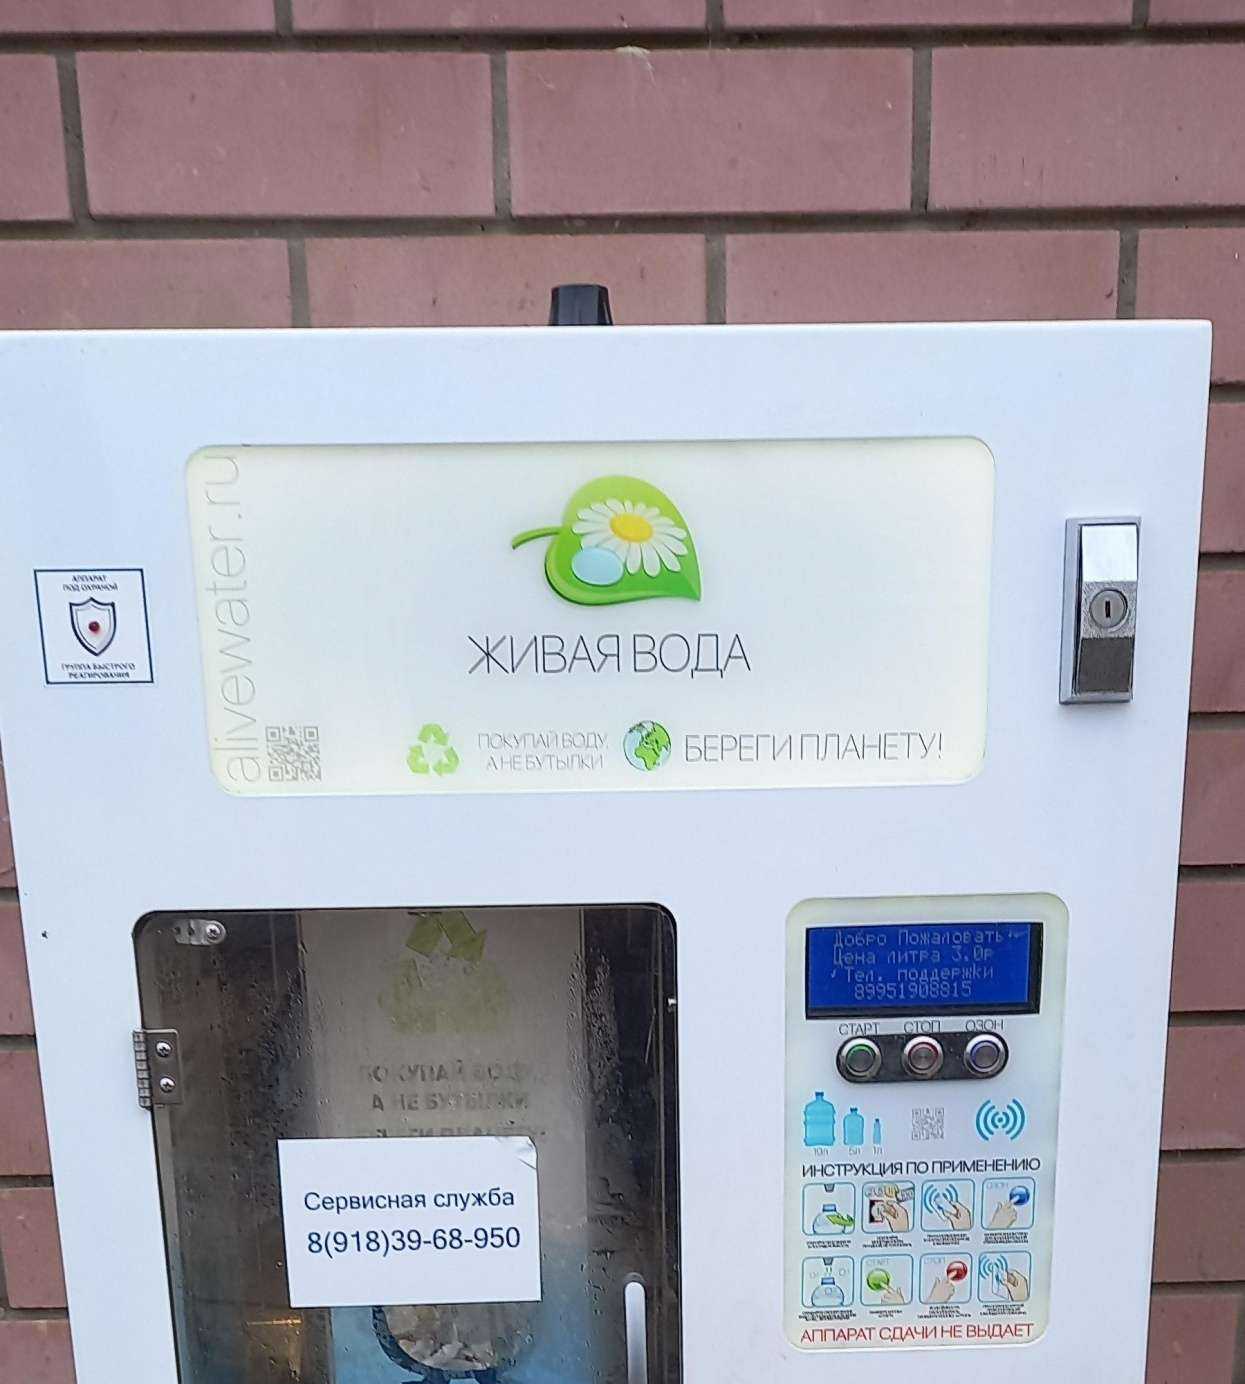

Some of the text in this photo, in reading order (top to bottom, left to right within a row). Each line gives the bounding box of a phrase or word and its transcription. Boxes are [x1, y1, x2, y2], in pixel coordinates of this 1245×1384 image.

[205, 455, 260, 783] alivewater.ru
[468, 632, 752, 679] ЖИВАЯ ВОДА
[478, 731, 559, 750] ПОКУПАЙ
[685, 731, 943, 763] БЕРЕГИ ПЛАНЕТУ!
[487, 754, 604, 771] А НЕ БУТЫЛКИ
[833, 929, 1003, 948] Добро Пожаловать
[833, 946, 876, 967] Цена
[888, 948, 941, 965] литра
[846, 964, 994, 983] Тел. поддержки
[838, 1022, 880, 1035] СТАРТ
[903, 1019, 942, 1034] СТОП
[965, 1018, 1004, 1032] ОЗОН
[802, 1157, 1041, 1178] ИНСТРУКЦИЯ ПО ПРИМЕНЕНИЮ
[303, 1187, 515, 1214] Сервисная служба
[308, 1225, 521, 1260] 8(918)39-68-950
[800, 1323, 1034, 1343] АППАРАТ СДАЧИ НЕ ВЫДАЕТ
